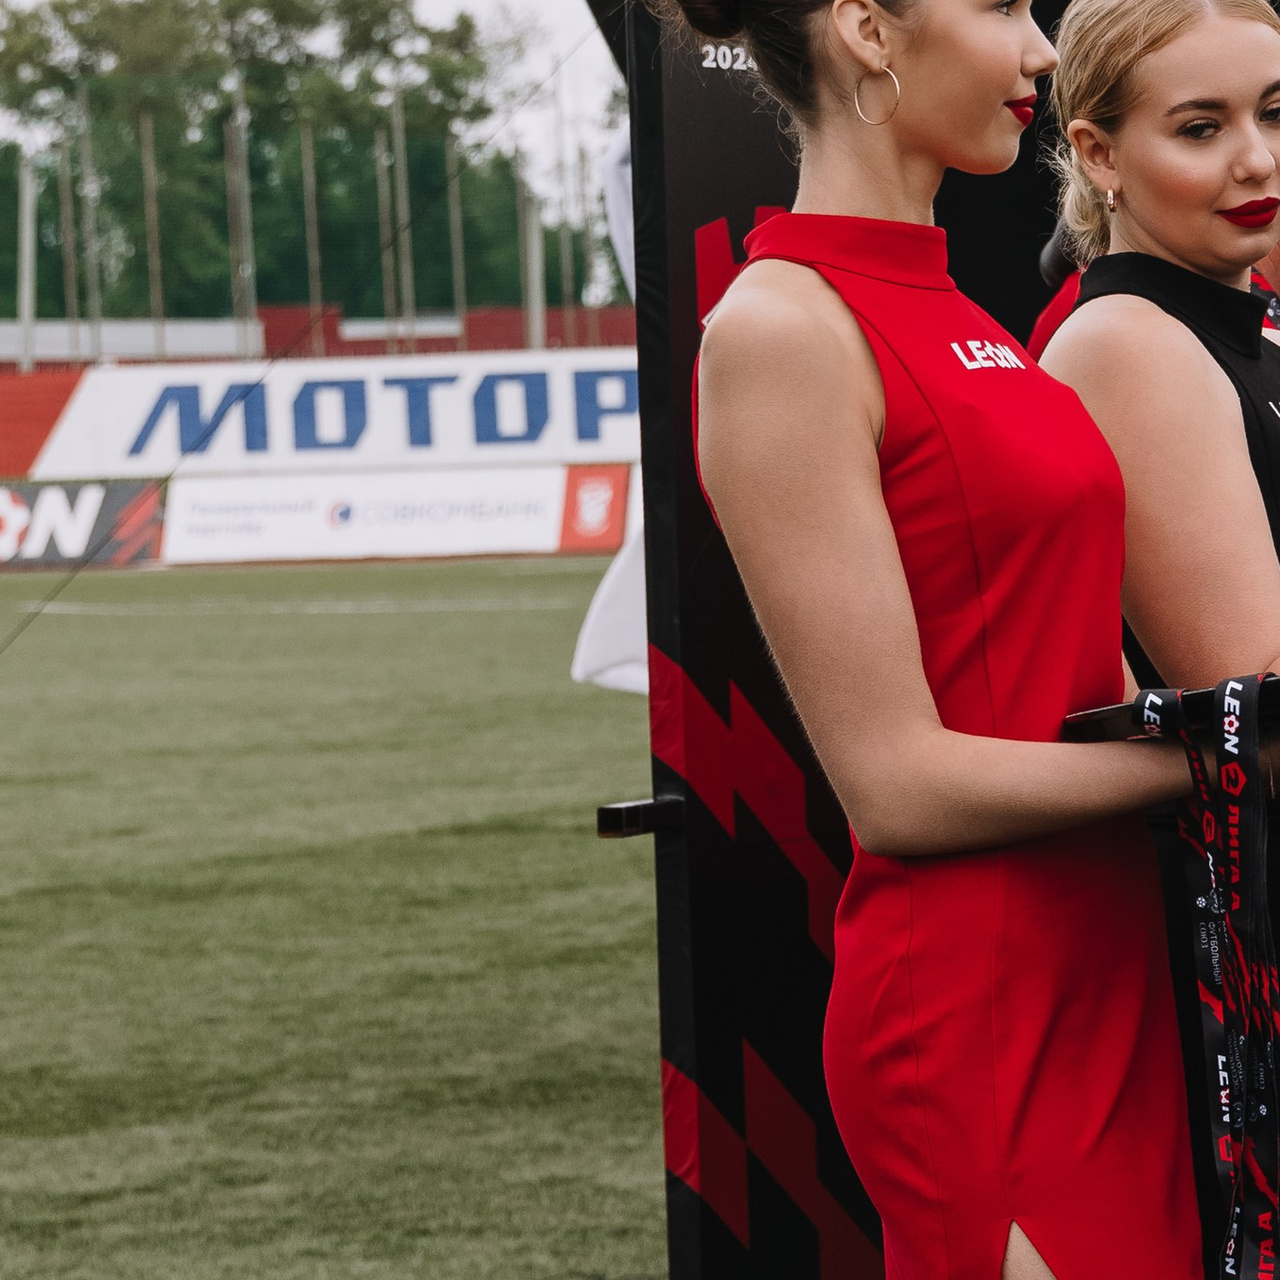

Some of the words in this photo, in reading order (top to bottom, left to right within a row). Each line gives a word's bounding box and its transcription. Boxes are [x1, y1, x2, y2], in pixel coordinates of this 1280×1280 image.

[950, 340, 1026, 371] LEON
[1143, 692, 1163, 739] LEO
[1223, 680, 1243, 755] LEON
[1227, 804, 1240, 884] ЛИГА
[1230, 891, 1241, 911] А
[1258, 1211, 1273, 1232] А
